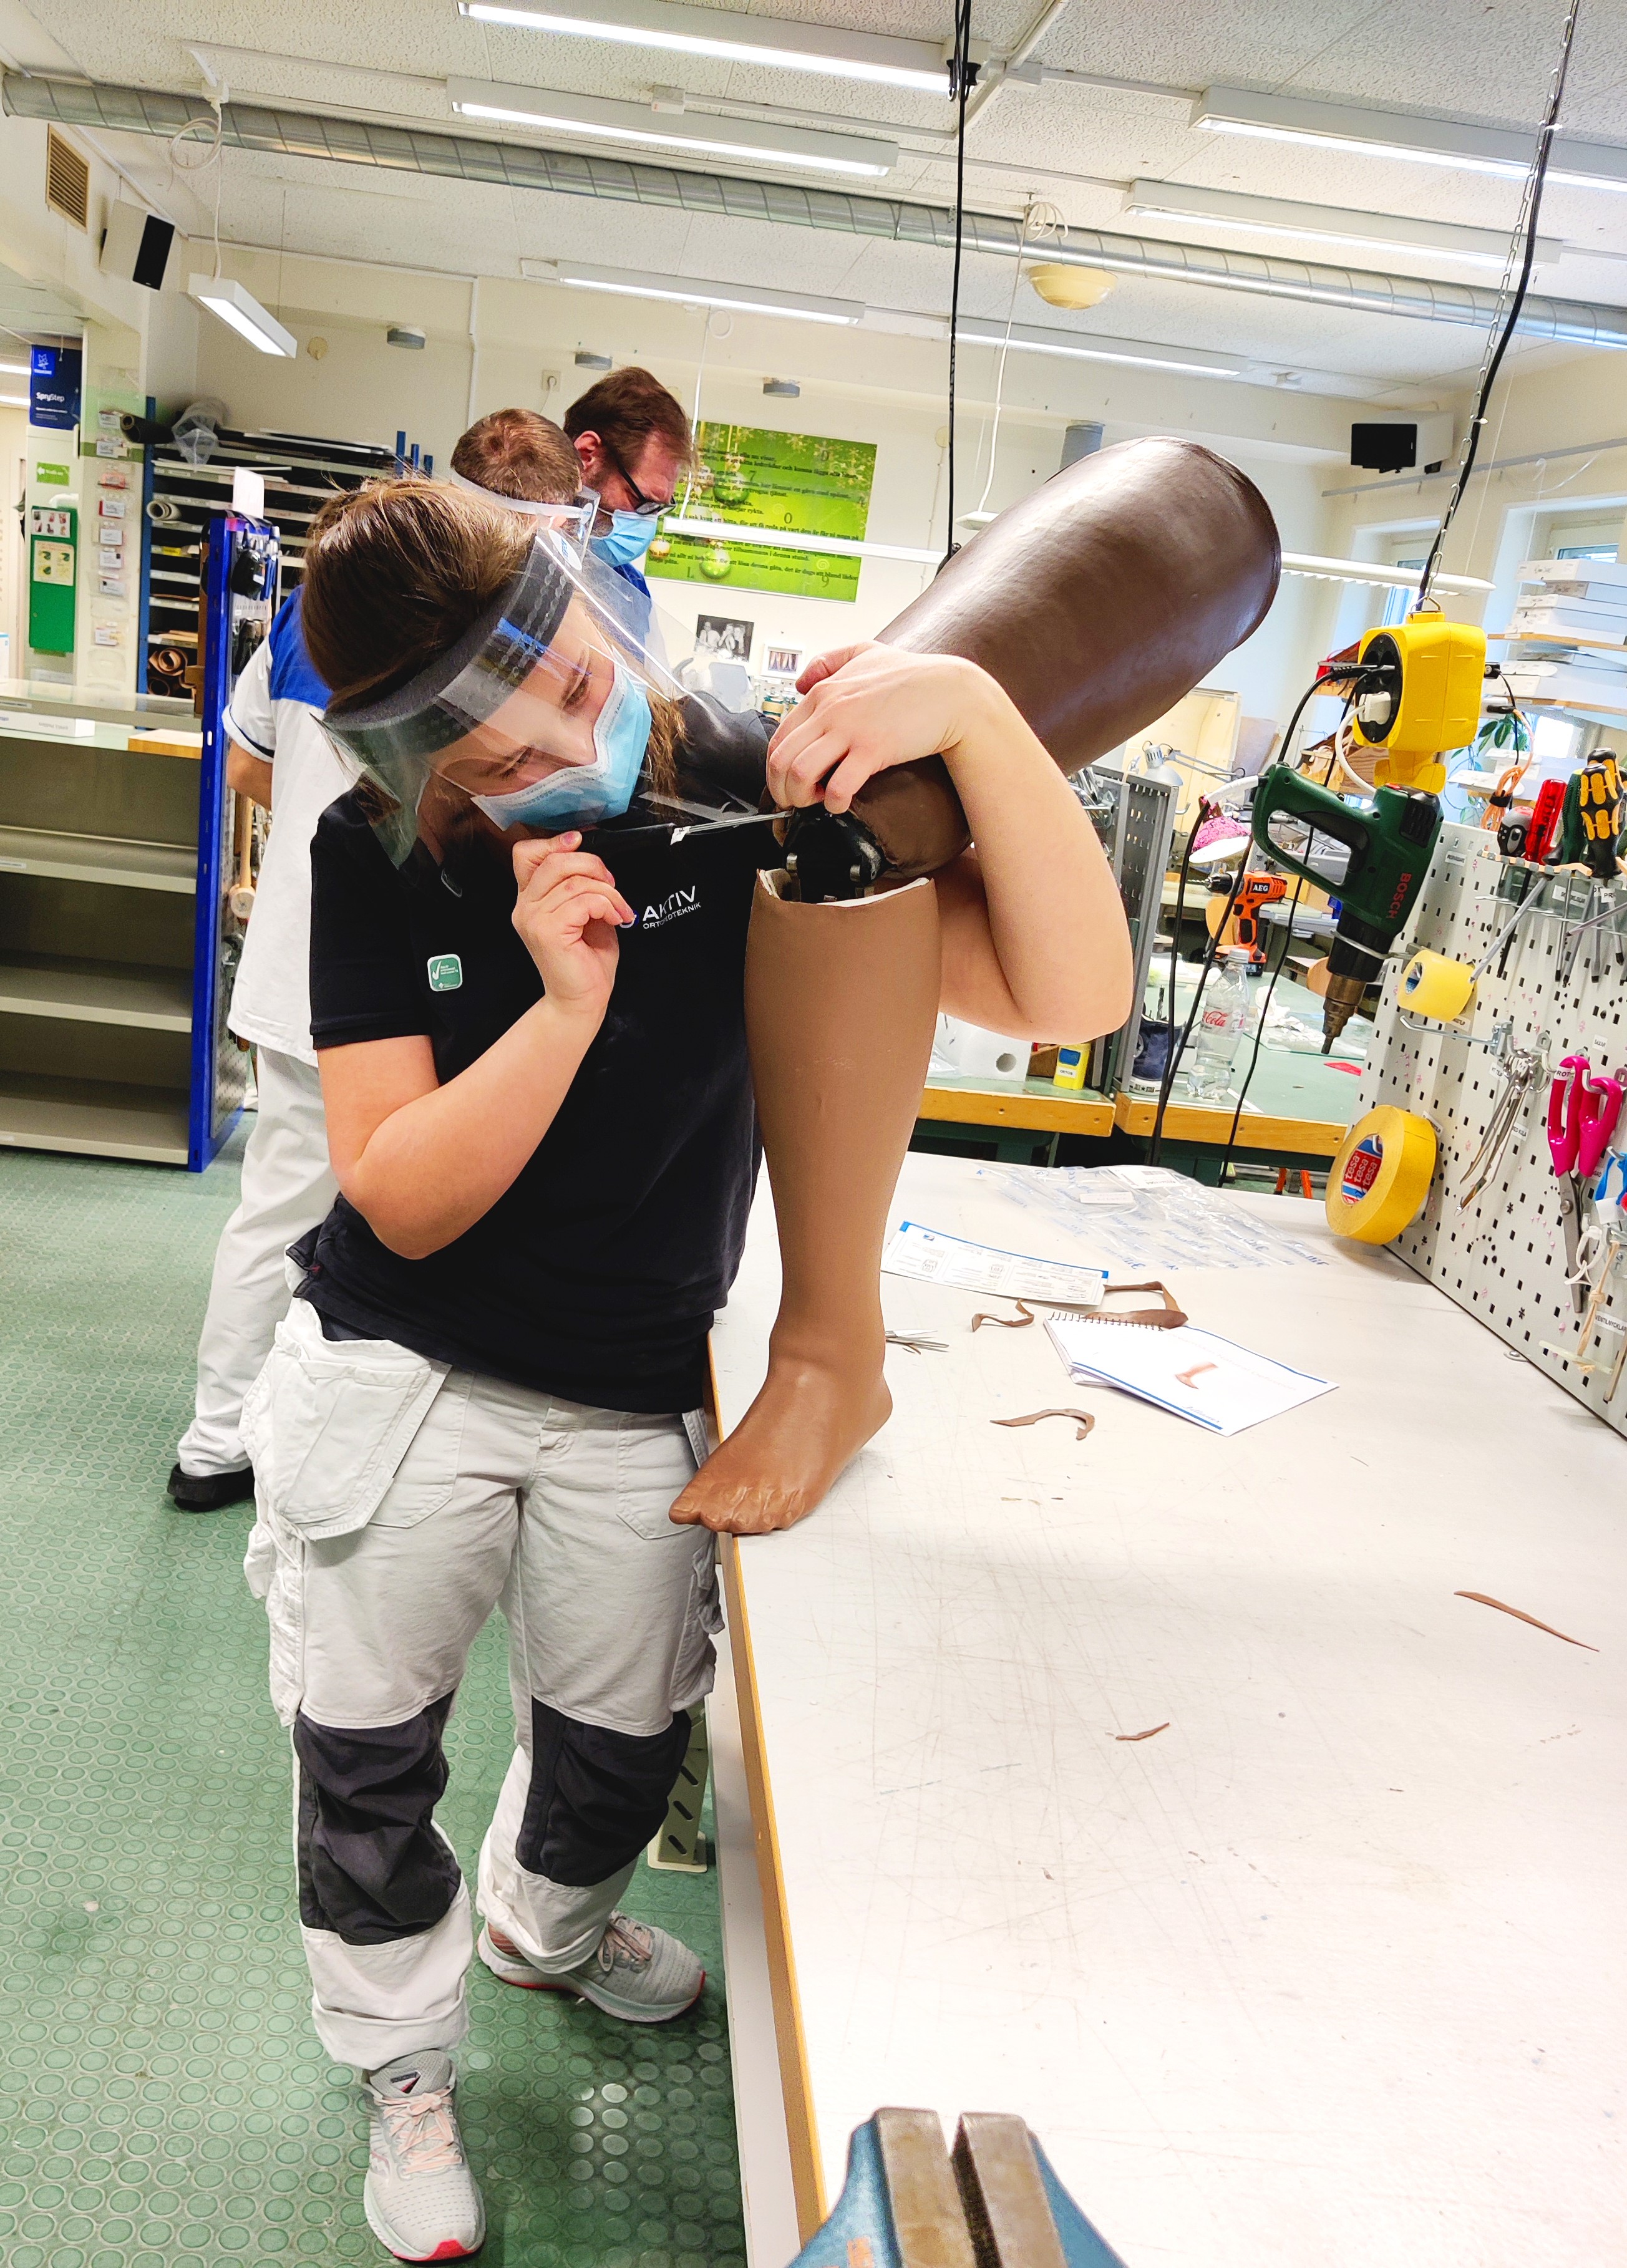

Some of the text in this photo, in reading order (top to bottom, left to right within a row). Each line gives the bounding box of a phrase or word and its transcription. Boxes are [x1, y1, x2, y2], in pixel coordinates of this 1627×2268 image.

[36, 392, 65, 403] SpryStep
[1252, 884, 1269, 892] AEG
[1386, 872, 1412, 919] BOSCH
[642, 885, 696, 921] AKTIV
[1344, 1155, 1361, 1180] tesa
[1354, 1158, 1369, 1183] tesa
[1362, 1161, 1377, 1186] tesa
